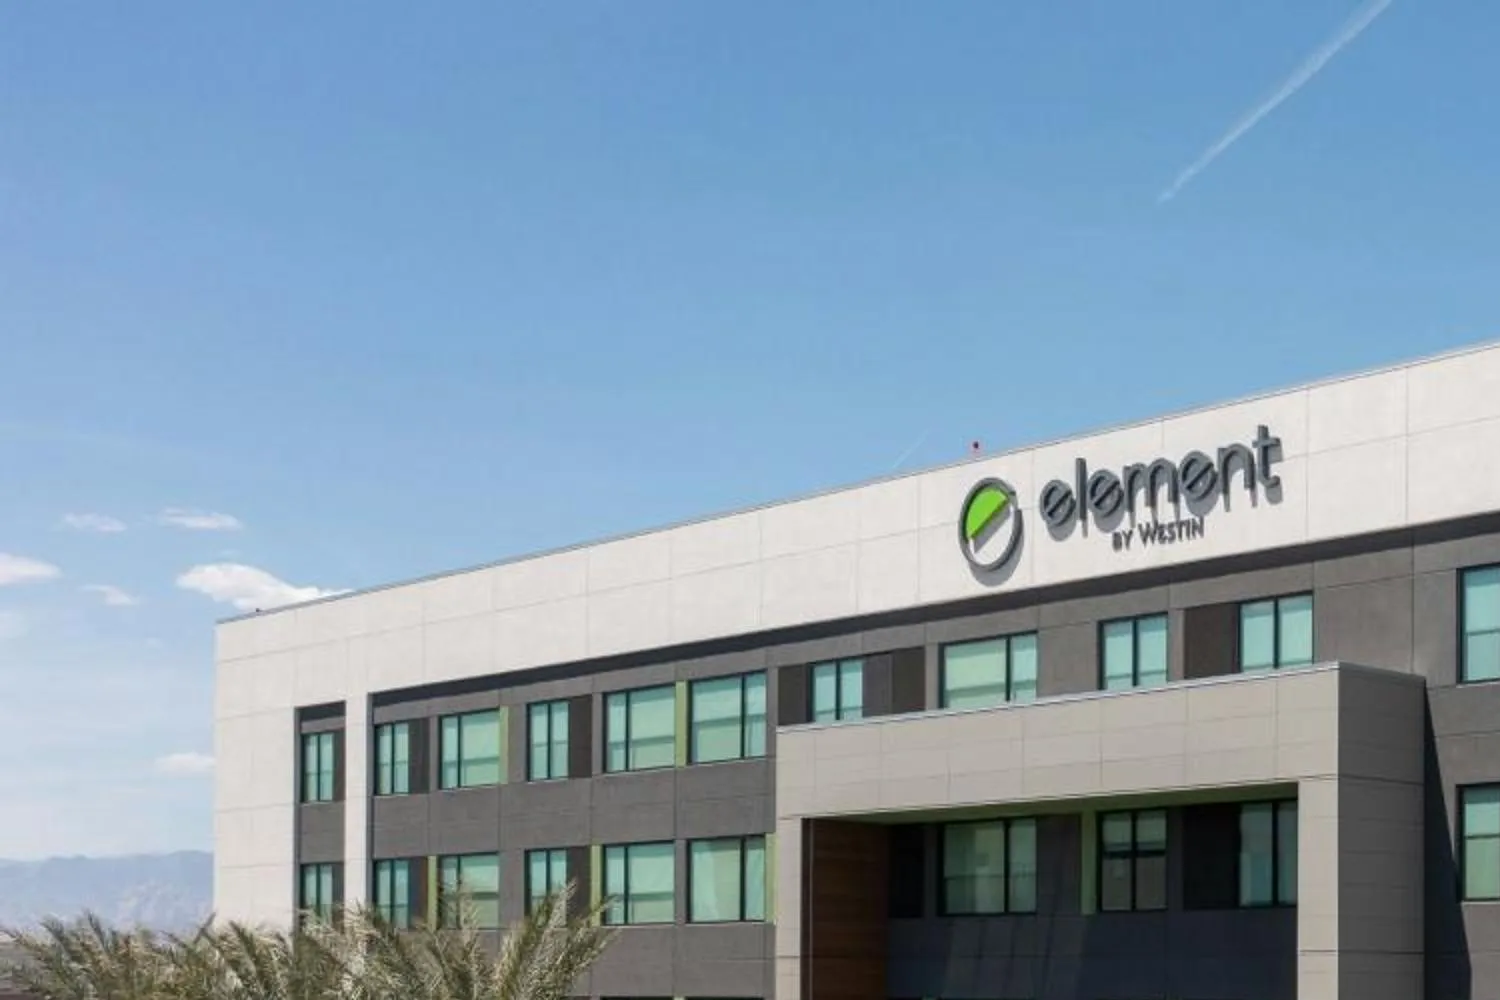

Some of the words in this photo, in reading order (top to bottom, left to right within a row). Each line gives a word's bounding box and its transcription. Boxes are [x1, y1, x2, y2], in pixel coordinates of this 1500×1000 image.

[1040, 424, 1282, 531] element
[1112, 529, 1133, 553] BY
[1138, 518, 1204, 547] WESTIN
